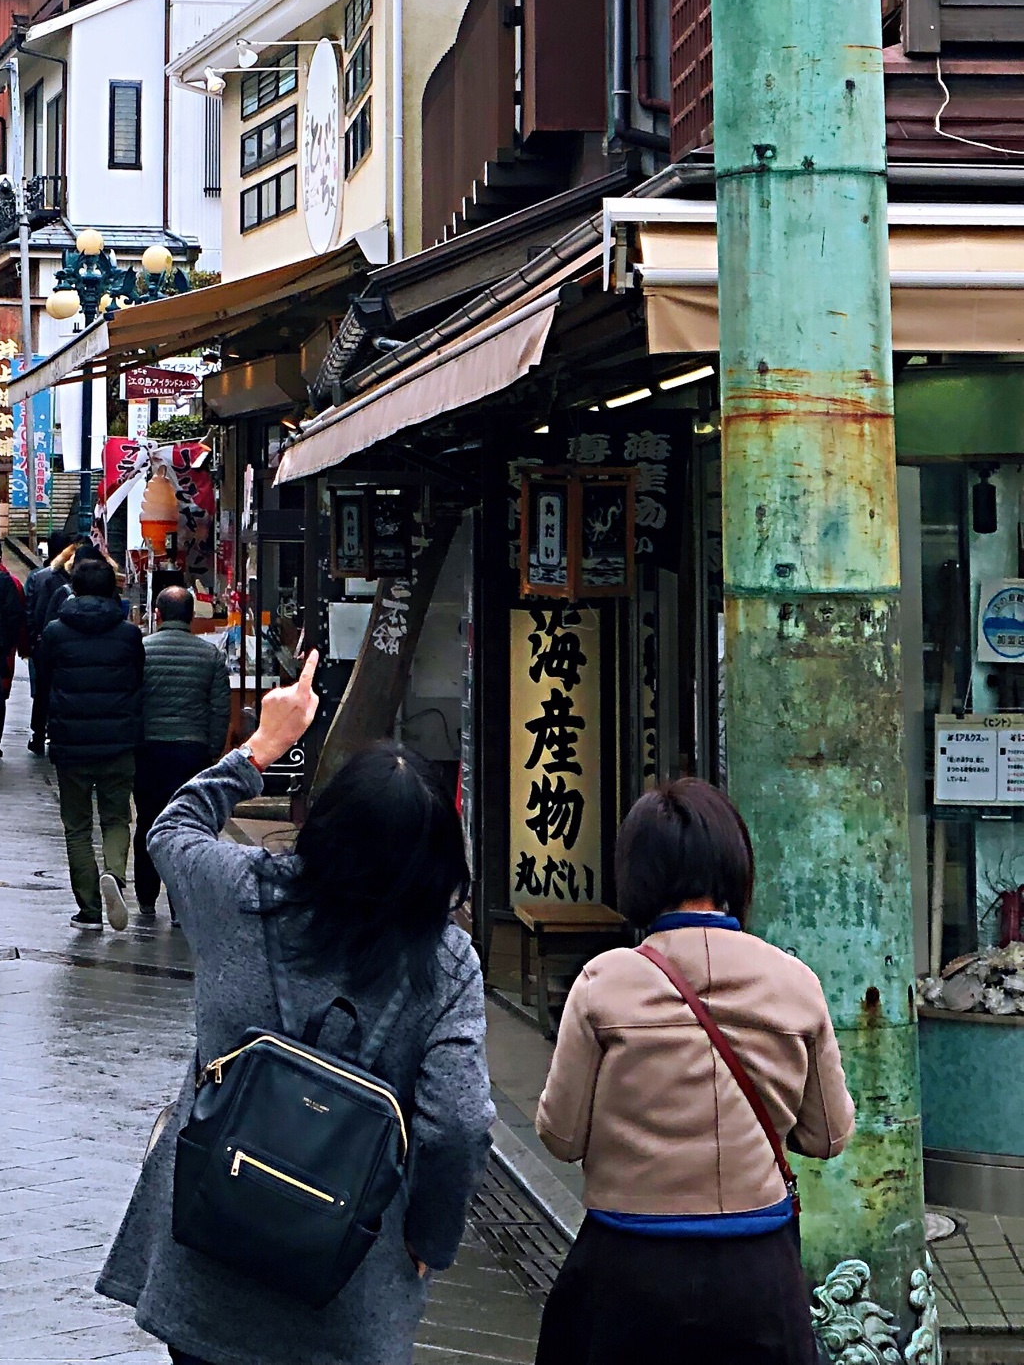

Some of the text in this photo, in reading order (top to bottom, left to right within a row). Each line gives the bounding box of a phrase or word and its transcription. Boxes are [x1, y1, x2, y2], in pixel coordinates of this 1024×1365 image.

[127, 376, 189, 387] 江の島アイランドスパ
[515, 851, 595, 903] 丸だい
